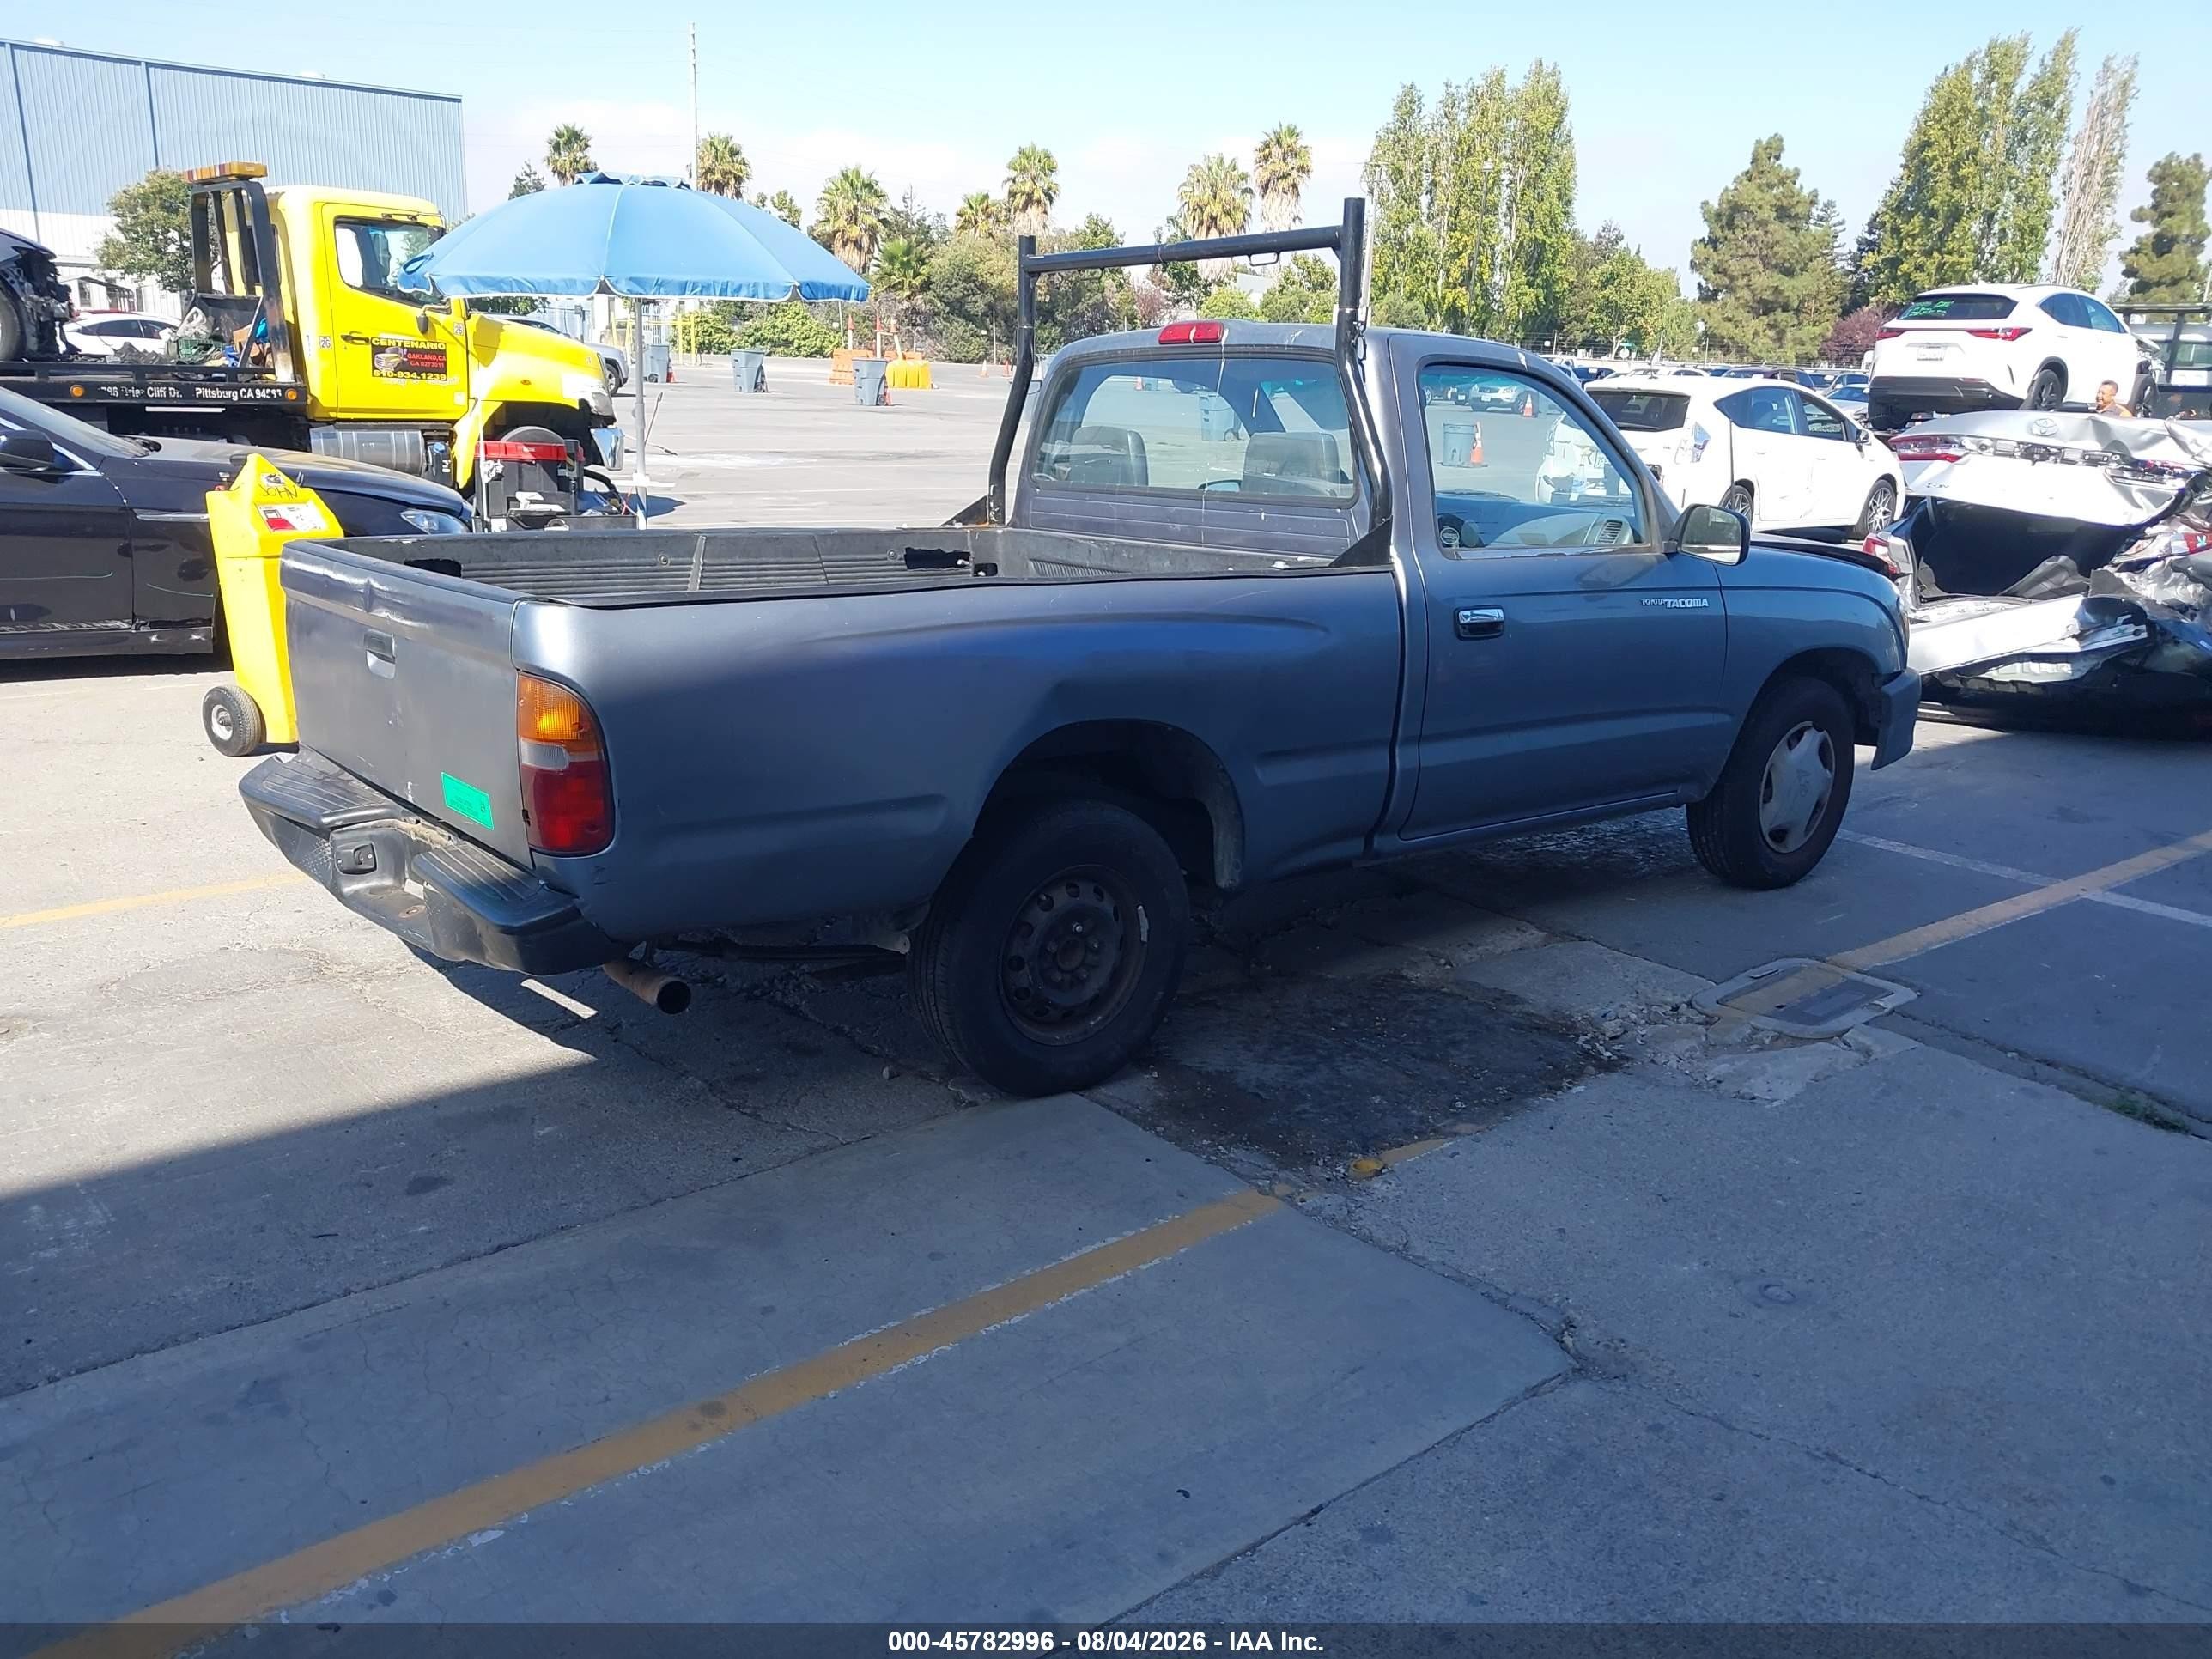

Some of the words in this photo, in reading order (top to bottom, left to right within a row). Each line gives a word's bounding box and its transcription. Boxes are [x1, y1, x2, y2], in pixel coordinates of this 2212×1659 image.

[371, 337, 446, 350] CENTENARIO
[147, 386, 167, 398] Cliff
[168, 386, 183, 398] Dr.
[195, 387, 239, 401] Pittsburg
[240, 388, 254, 398] CA
[258, 483, 298, 499] JOHN
[1663, 598, 1709, 608] TACOMA
